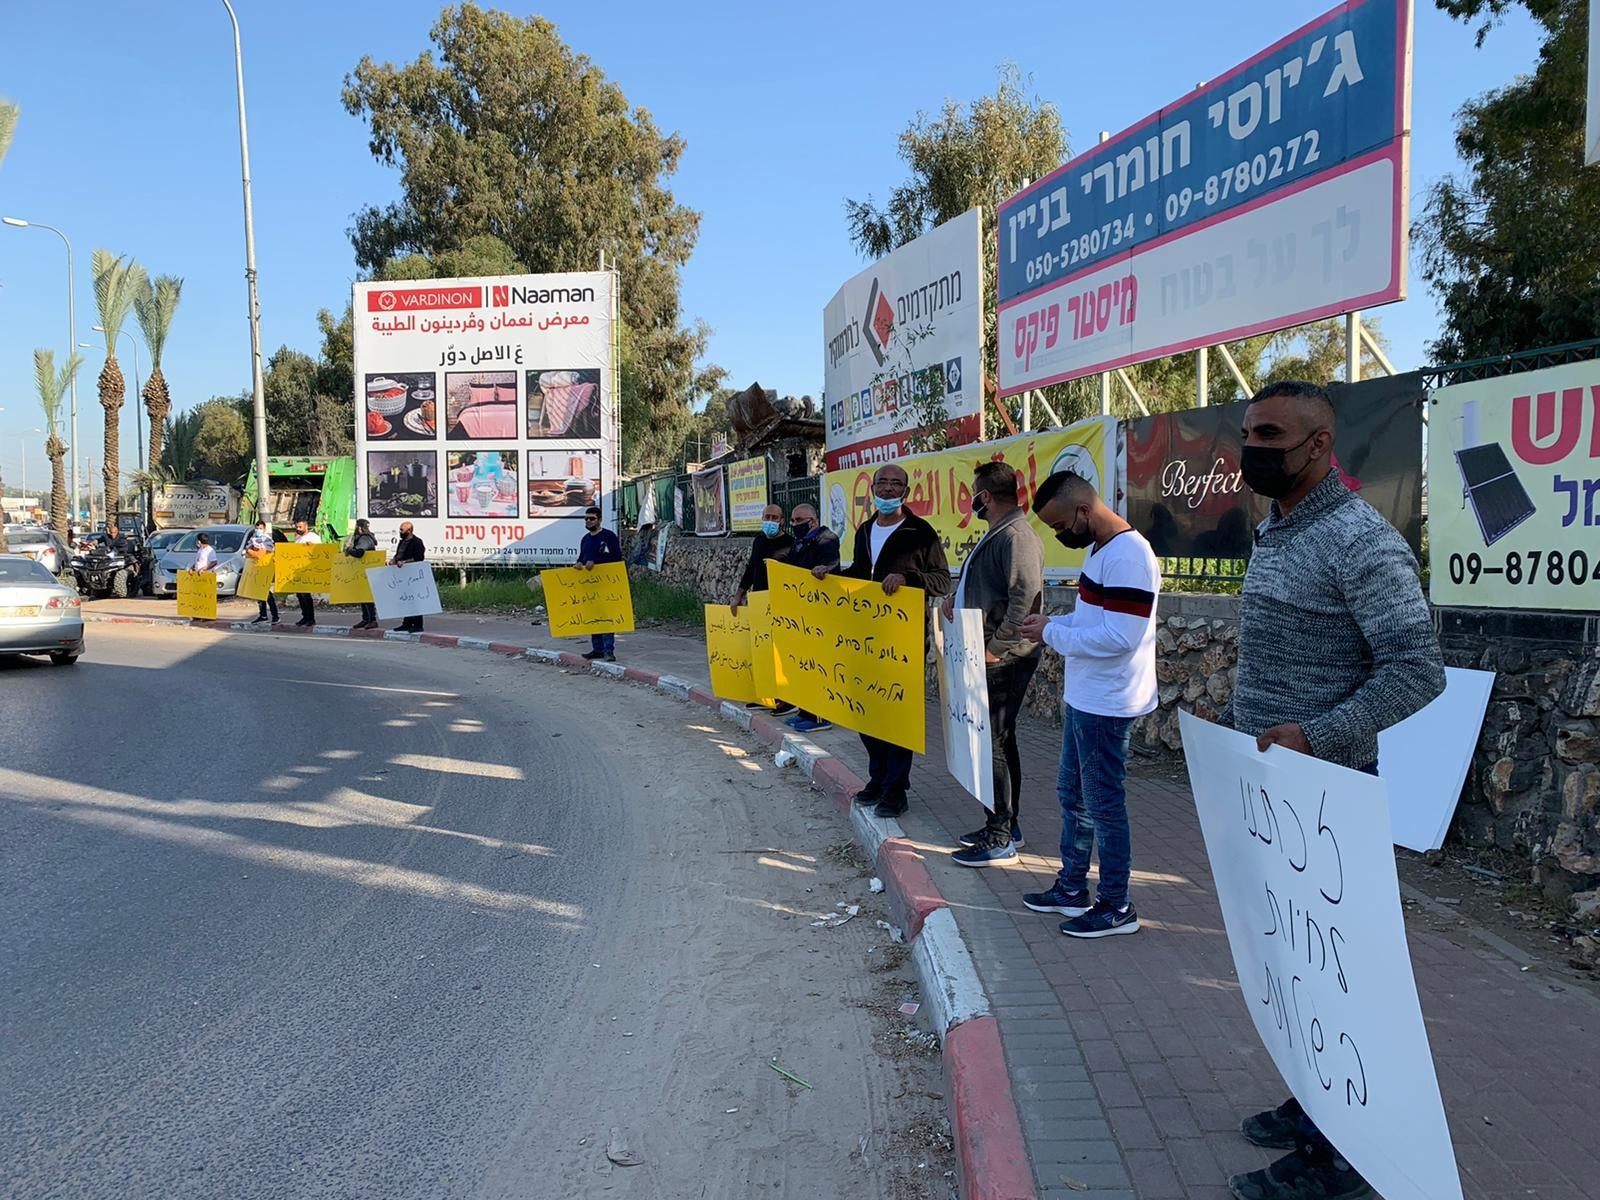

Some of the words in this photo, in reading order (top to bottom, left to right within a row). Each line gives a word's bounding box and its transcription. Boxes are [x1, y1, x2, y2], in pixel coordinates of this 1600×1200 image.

[1080, 119, 1191, 206] חומרי
[1025, 212, 1135, 285] 050-5280734
[1165, 128, 1320, 222] 09-8780272
[1008, 185, 1071, 264] בניין
[401, 293, 473, 306] VARDINON
[512, 286, 594, 305] Naaman
[897, 270, 961, 325] מתקדמים
[1067, 275, 1137, 340] מיסטר
[372, 315, 415, 335] الطيبة
[490, 312, 533, 330] نعمان
[538, 312, 589, 330] معرض
[1015, 304, 1059, 372] פיקס
[1161, 457, 1244, 509] Berfect
[445, 525, 485, 540] טייבה
[491, 525, 525, 545] סניף
[425, 546, 477, 554] -7990507
[503, 547, 512, 555] 24
